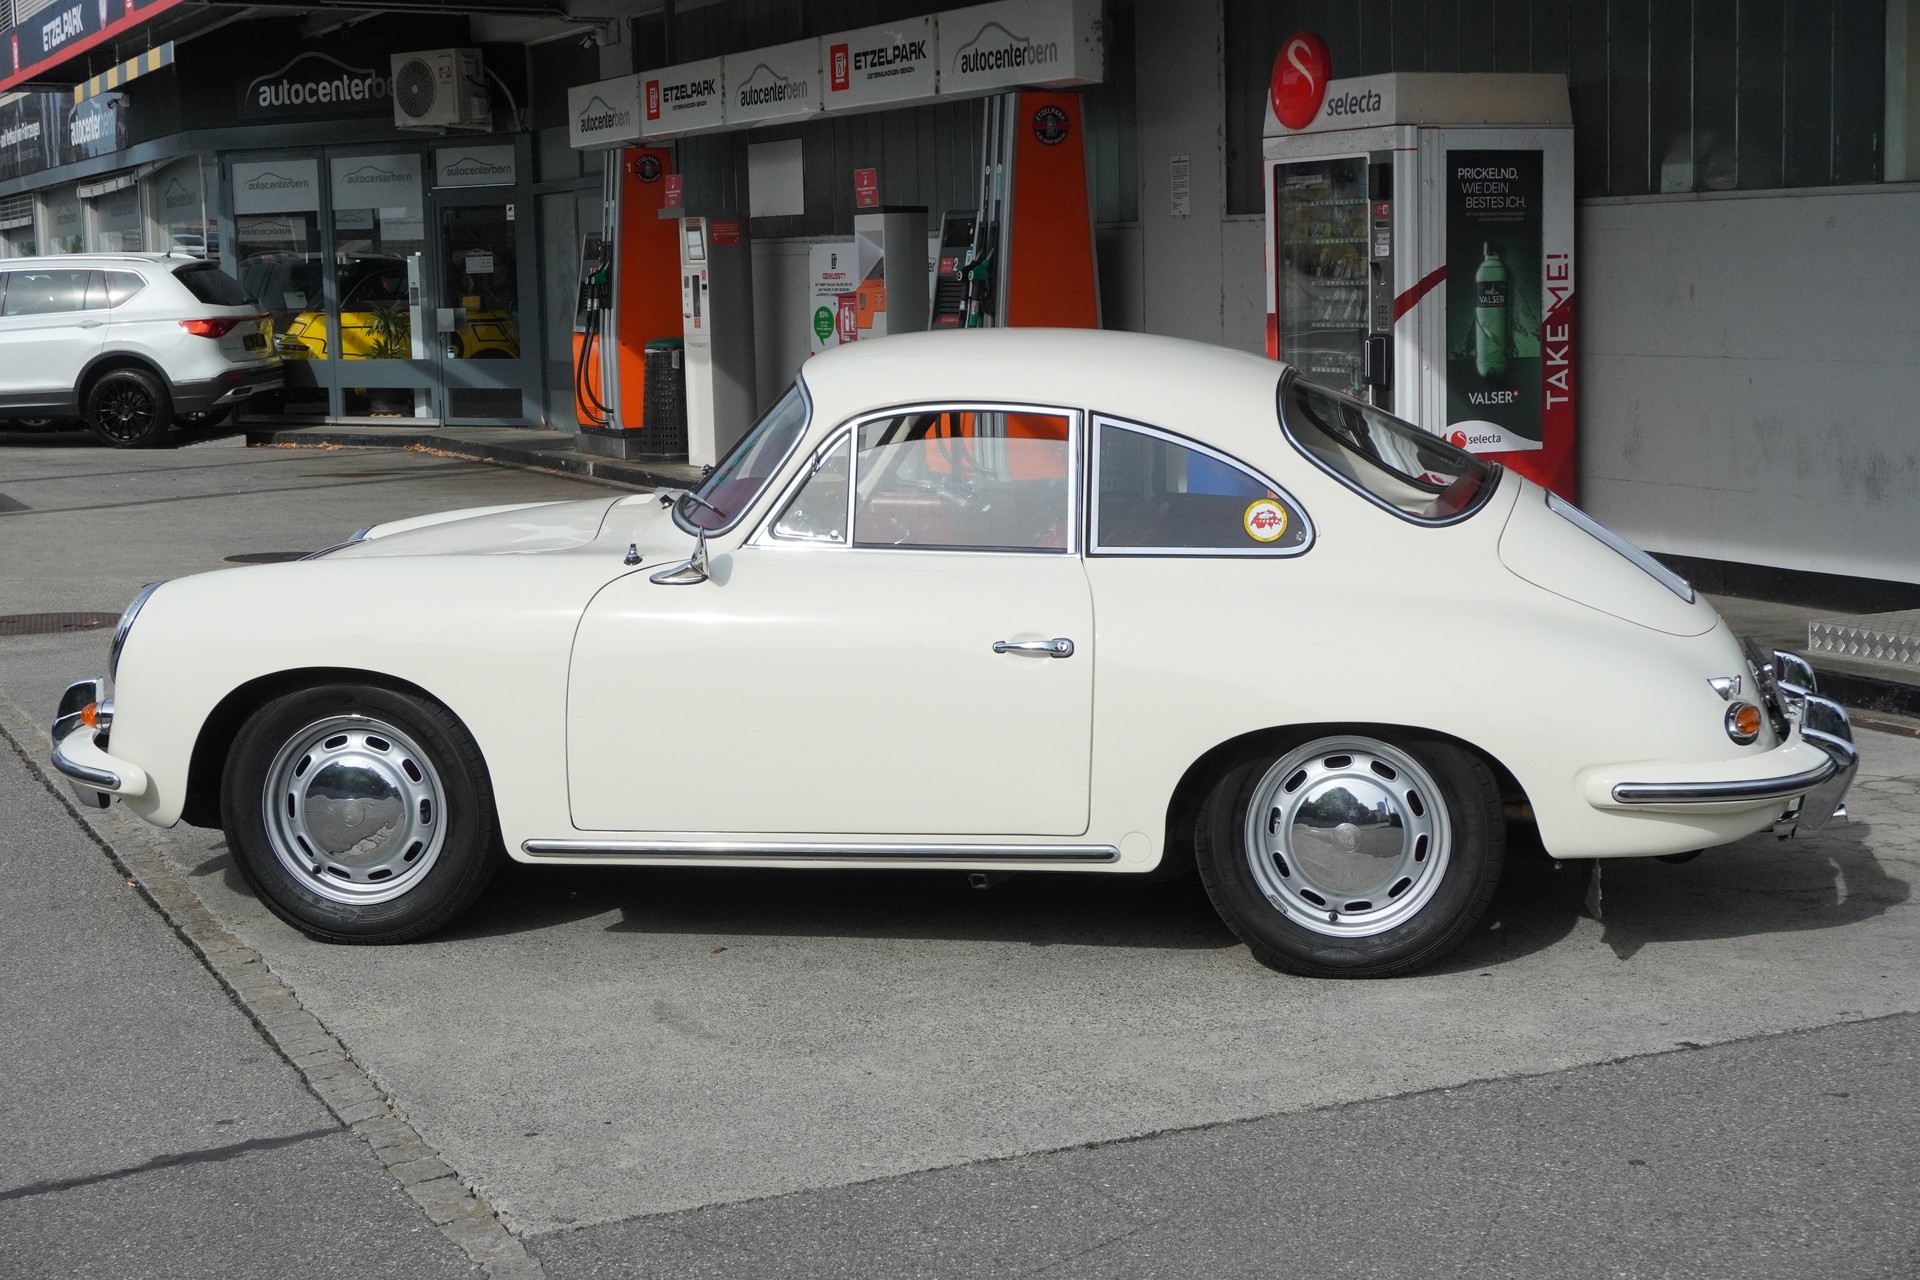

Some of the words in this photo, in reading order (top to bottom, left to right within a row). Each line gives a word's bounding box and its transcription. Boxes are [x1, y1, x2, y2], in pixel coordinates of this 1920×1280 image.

[42, 4, 84, 52] ETZELPARK
[854, 40, 927, 70] ETZELPARK
[961, 38, 1058, 74] autocenterbern
[663, 79, 716, 103] ETZELPARK
[740, 78, 808, 107] autocenterbern
[1327, 89, 1381, 117] selecta
[580, 109, 631, 133] autocenterbern
[1035, 107, 1066, 122] ETZELPARK
[71, 109, 115, 146] autocenterbern
[447, 163, 512, 177] autocenterbern
[626, 162, 631, 173] 1
[1457, 167, 1519, 180] PRICKELND,
[248, 178, 309, 191] autocenterbern
[347, 171, 412, 184] autocenterbern
[1461, 182, 1482, 194] WIE
[1484, 182, 1509, 194] DEIN
[1465, 196, 1504, 209] BESTES
[1506, 196, 1527, 208] ICH.
[952, 257, 959, 271] 2
[1546, 253, 1569, 313] ME!
[1479, 295, 1505, 304] VALSER
[1546, 323, 1569, 410] TAKE
[1468, 391, 1513, 405] VALSER
[1468, 434, 1501, 445] selecta
